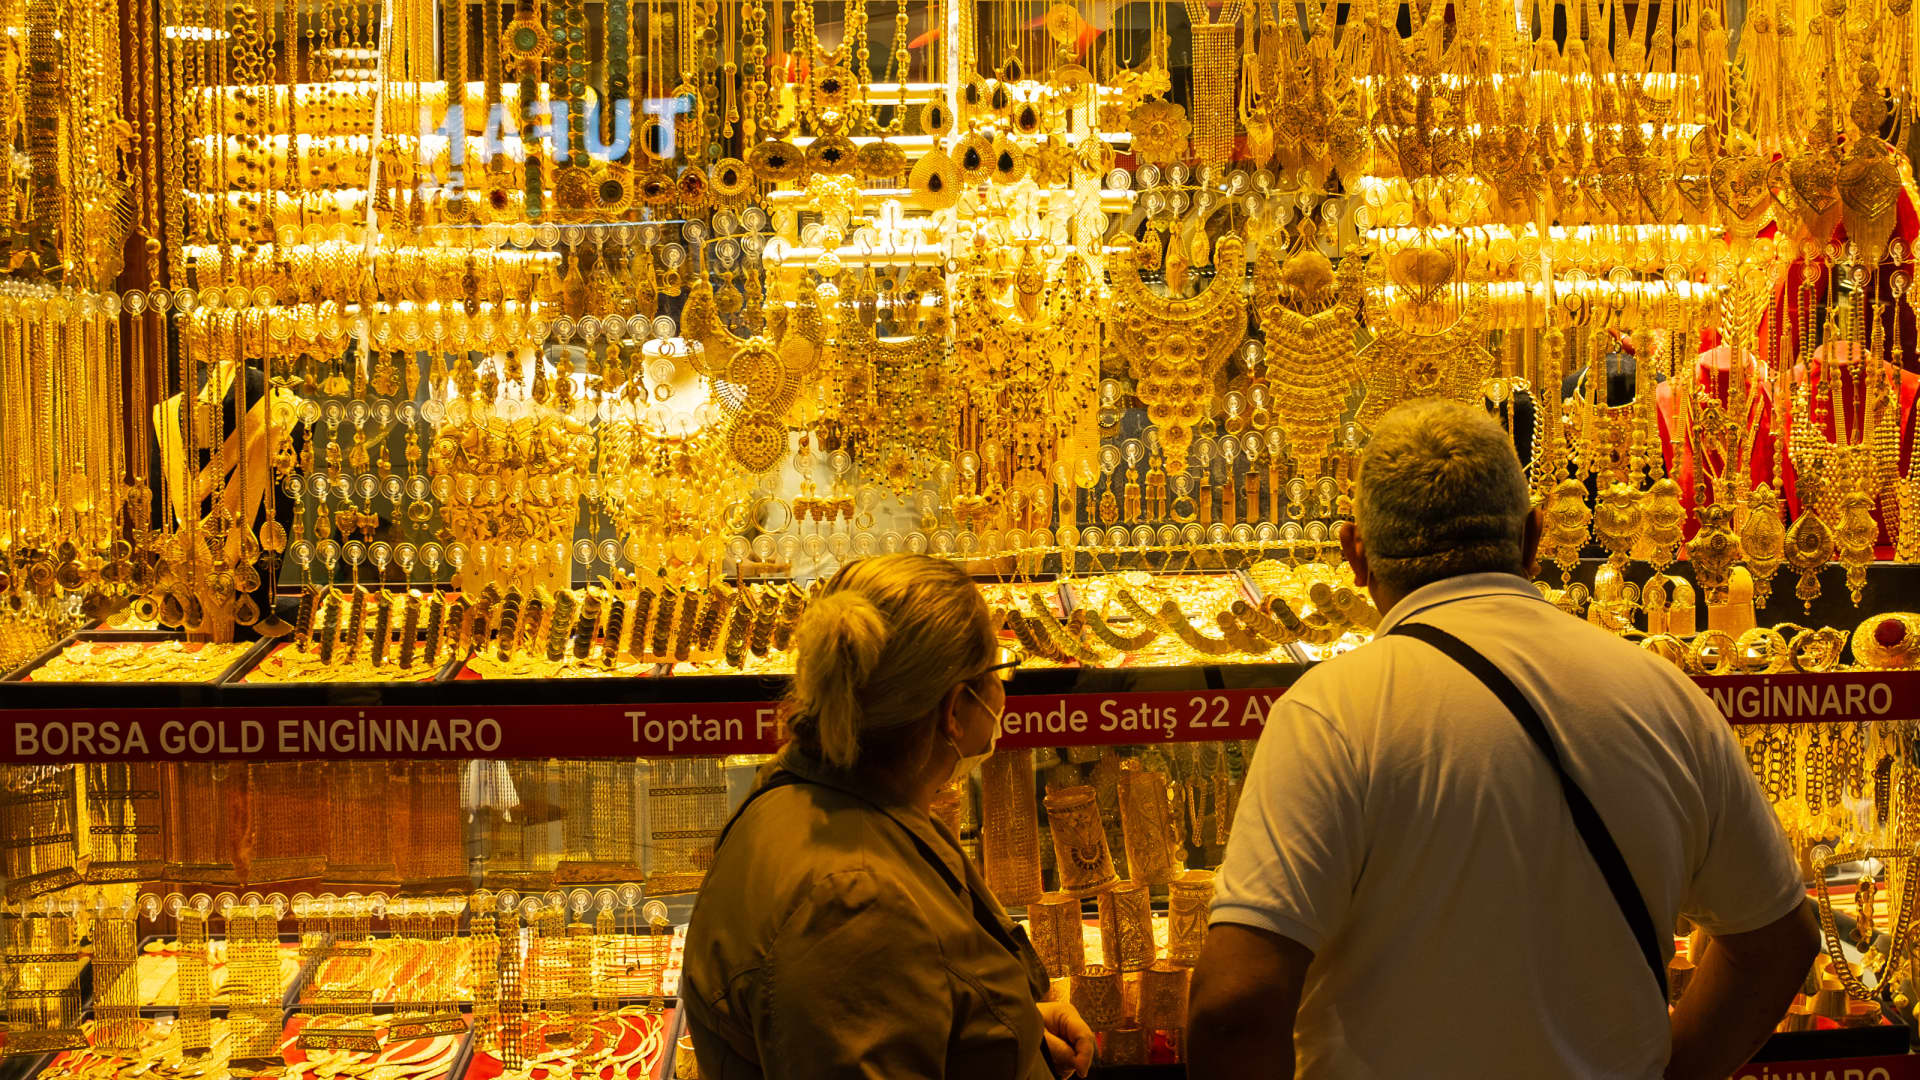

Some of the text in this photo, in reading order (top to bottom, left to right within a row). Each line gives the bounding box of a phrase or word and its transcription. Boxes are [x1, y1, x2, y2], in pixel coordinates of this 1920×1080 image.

[1702, 678, 1892, 718] NGİNNARO
[15, 711, 502, 755] BORSA GOLD ENGİNNARO
[624, 711, 743, 751] Toptan
[1100, 700, 1177, 738] Satış
[1188, 696, 1230, 728] 22
